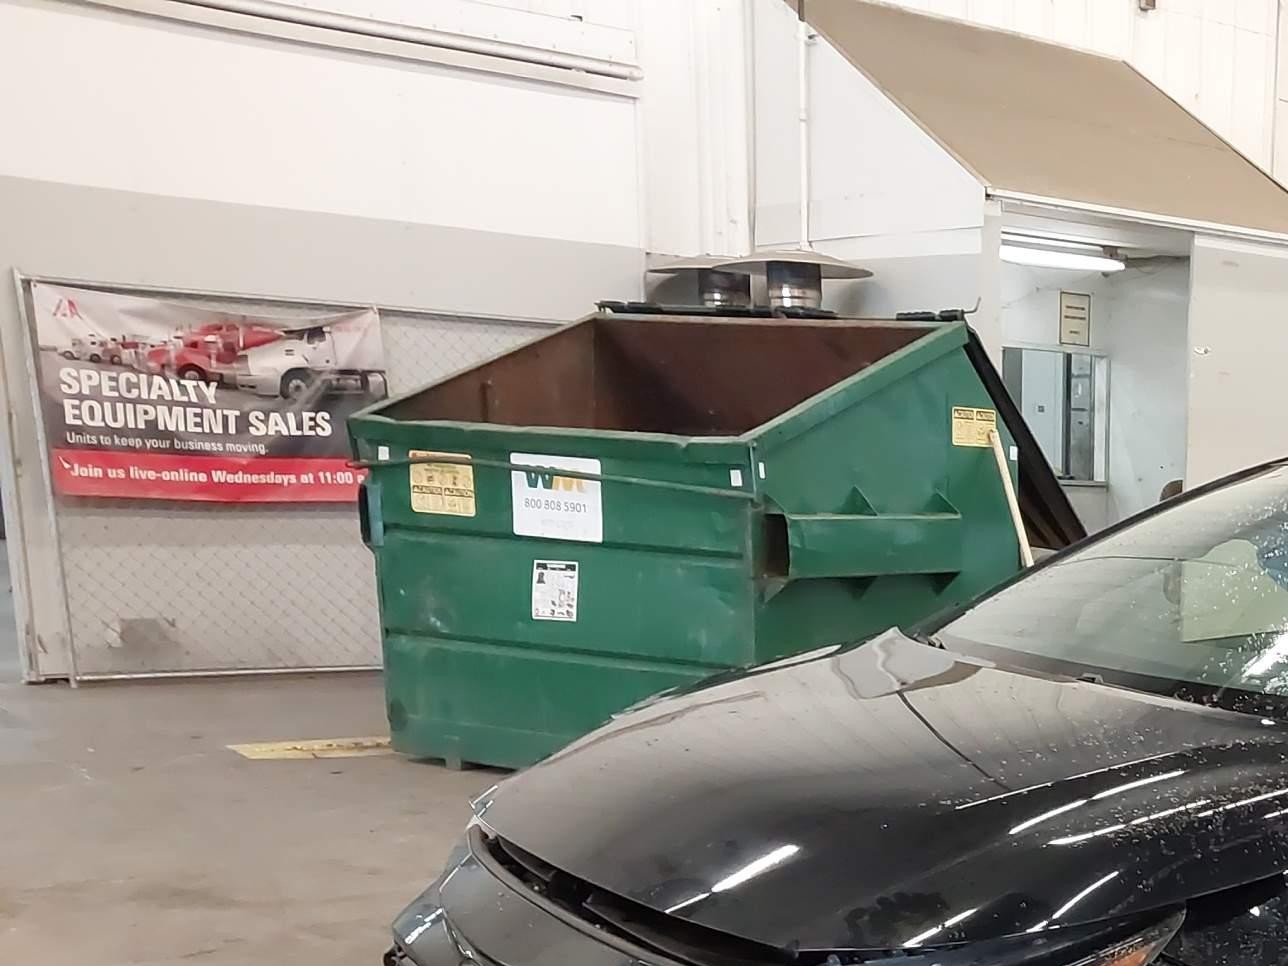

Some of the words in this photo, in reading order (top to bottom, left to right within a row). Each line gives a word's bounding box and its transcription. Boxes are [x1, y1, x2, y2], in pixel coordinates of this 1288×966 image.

[58, 367, 218, 404] SPECIALTY
[63, 399, 241, 435] EQUIPMENT
[248, 410, 333, 437] SALES
[66, 432, 97, 445] Units
[99, 434, 112, 446] to
[114, 433, 143, 449] keep
[144, 437, 170, 450] your
[174, 436, 223, 452] business
[225, 441, 269, 456] moving.
[70, 463, 103, 478] Join
[108, 468, 125, 480] us
[129, 466, 208, 483] live-online
[211, 470, 297, 487] Wednesdays
[300, 471, 315, 484] at
[319, 471, 353, 485] 11:00
[524, 497, 542, 510] 800
[563, 501, 587, 513] 5901
